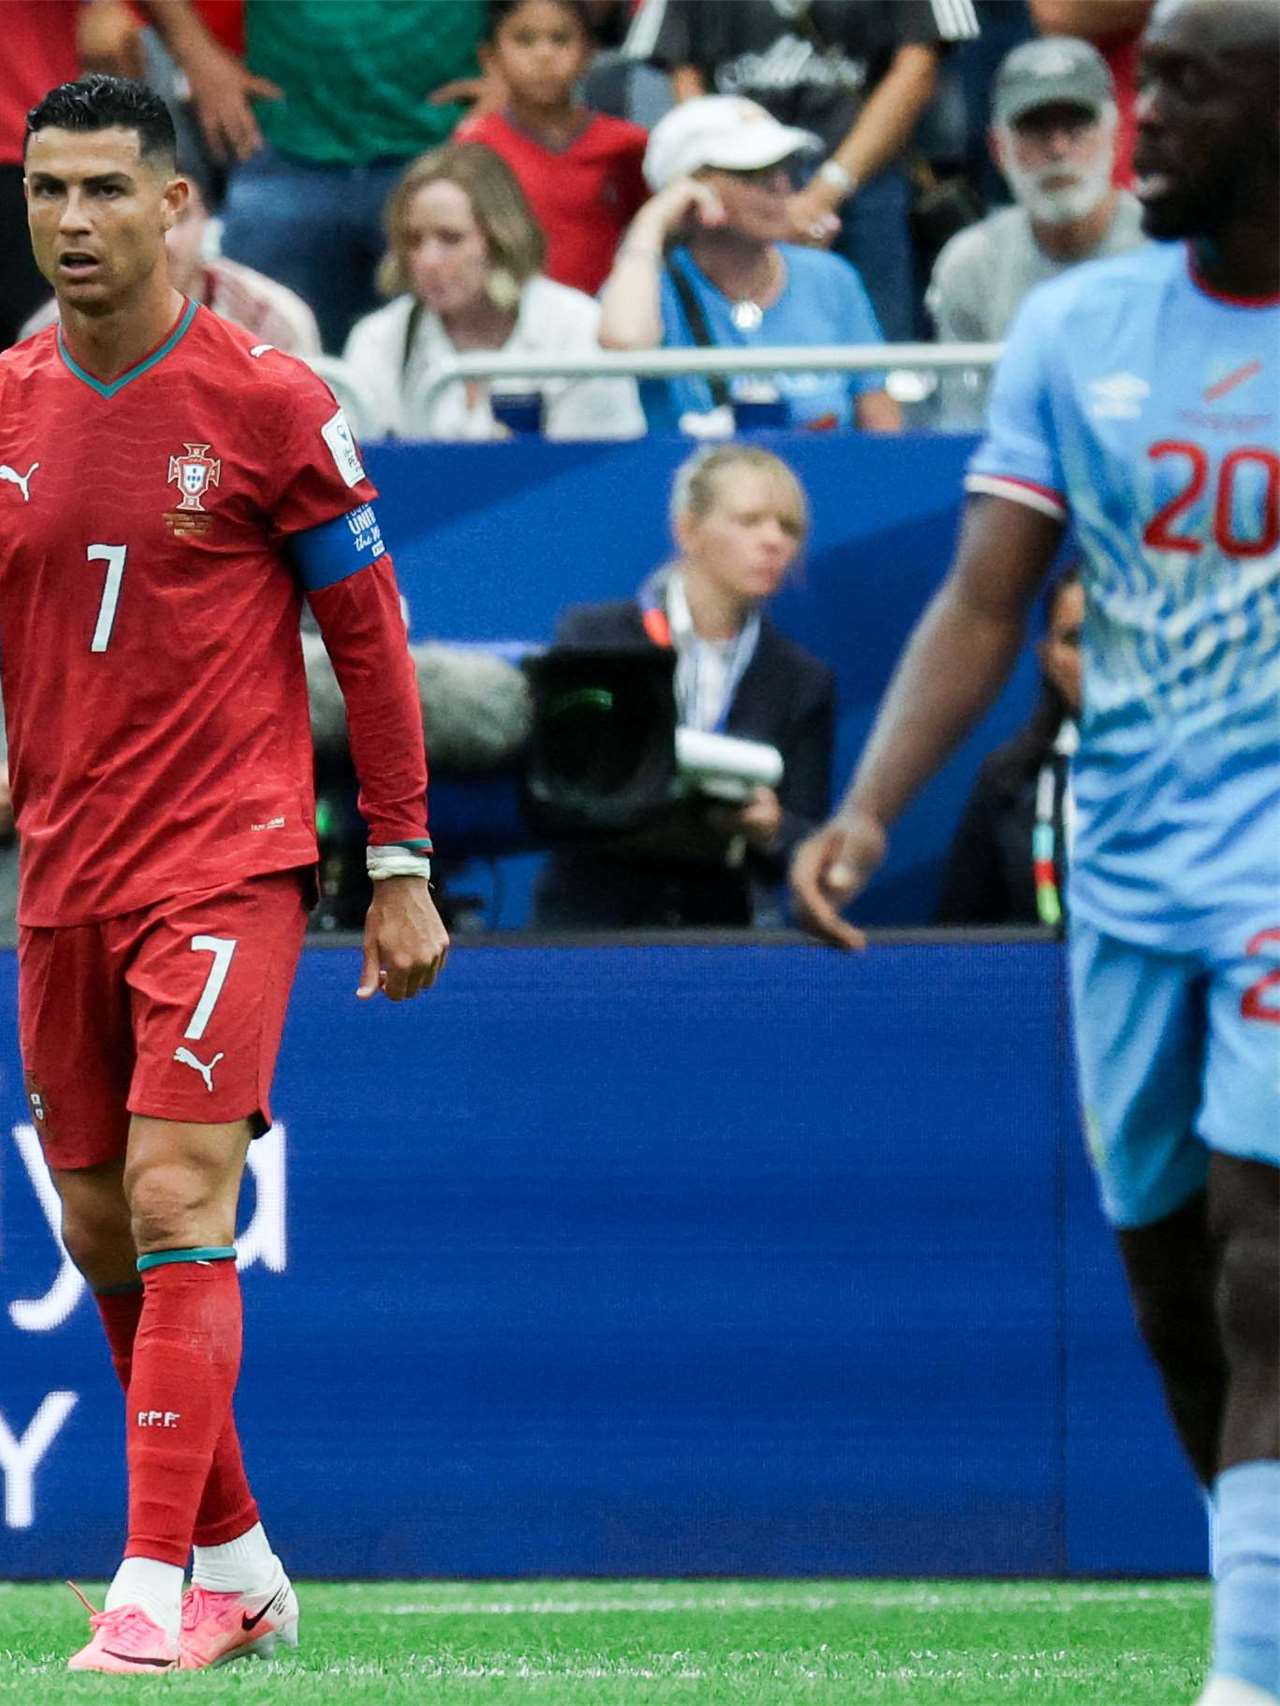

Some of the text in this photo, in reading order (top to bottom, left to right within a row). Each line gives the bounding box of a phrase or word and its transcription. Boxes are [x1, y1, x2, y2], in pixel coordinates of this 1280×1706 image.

[1143, 438, 1280, 561] 20
[87, 543, 127, 653] 7
[183, 934, 238, 1041] 7
